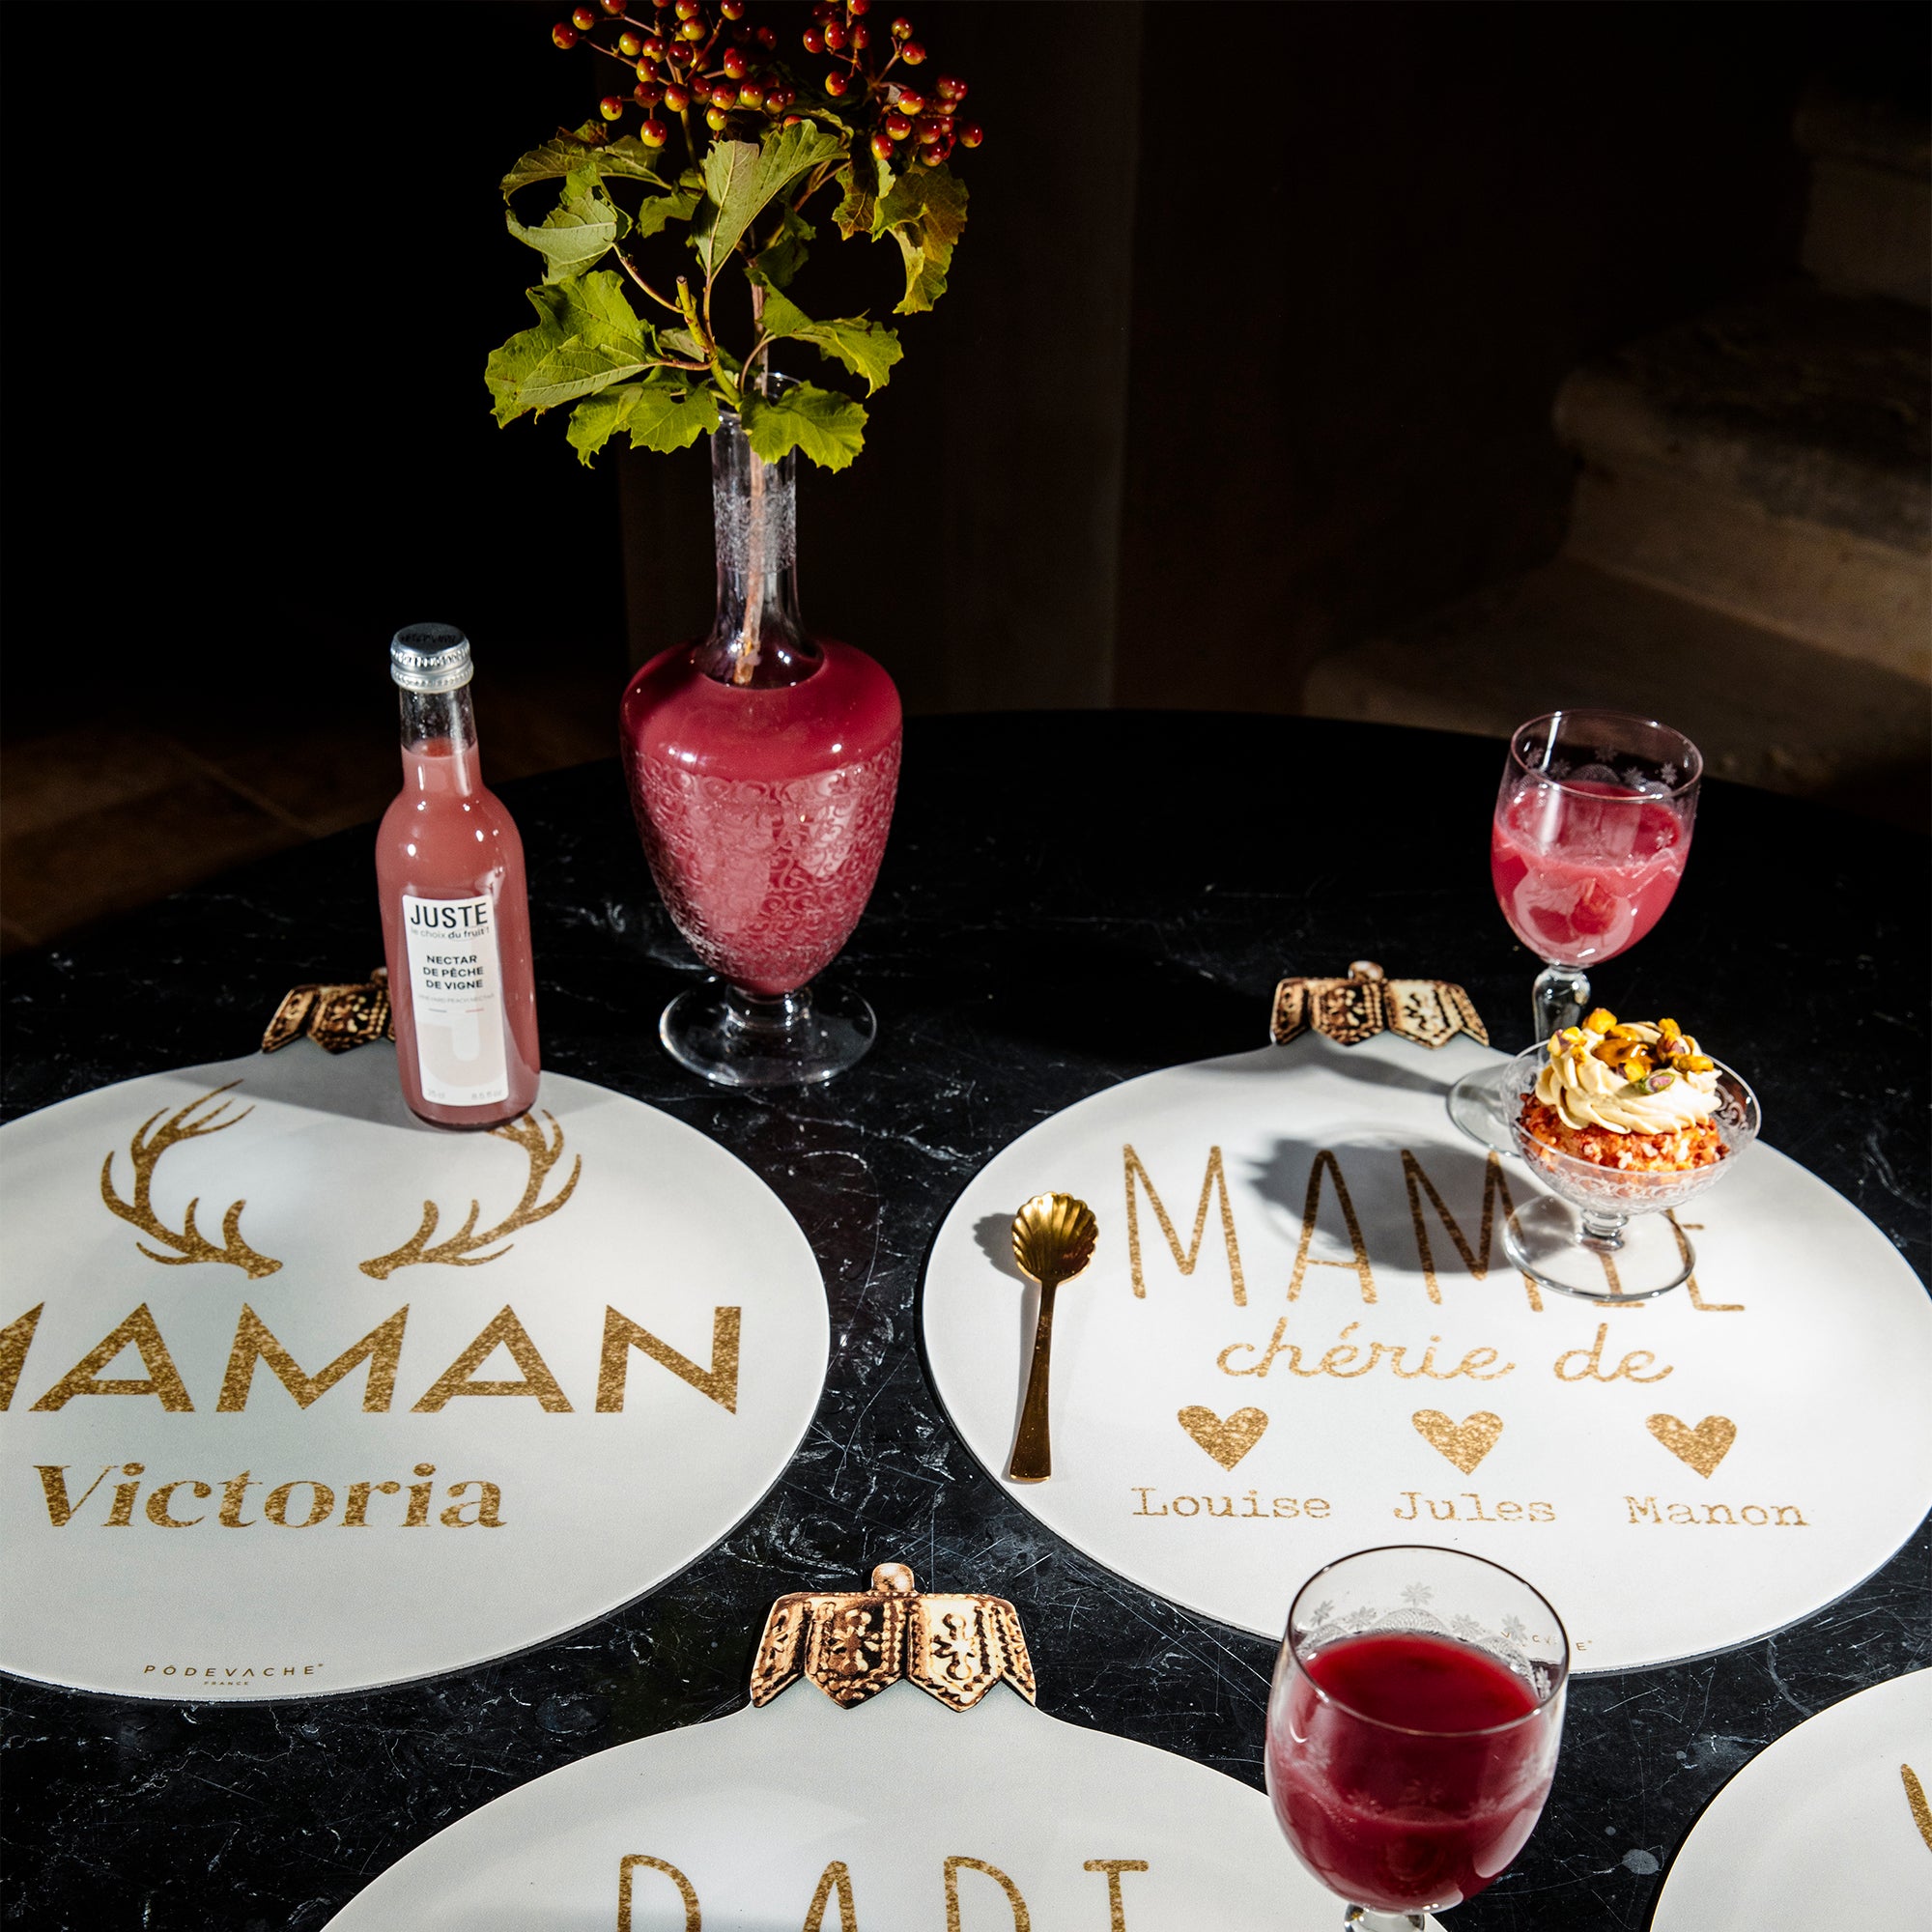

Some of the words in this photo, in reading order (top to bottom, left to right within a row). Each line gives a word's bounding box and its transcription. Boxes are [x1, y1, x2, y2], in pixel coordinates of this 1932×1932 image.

[411, 902, 488, 928] JUSTE
[420, 930, 444, 939] choix
[464, 928, 484, 938] fruit
[423, 967, 439, 977] DE
[441, 966, 484, 978] PÊCHE
[427, 954, 477, 965] NECTAR
[426, 980, 441, 989] DE
[444, 980, 483, 990] VIGNE
[0, 1302, 742, 1415] AMAN
[1217, 1316, 1516, 1380] chérie
[1553, 1323, 1674, 1383] de
[32, 1462, 507, 1528] Victoria
[1131, 1488, 1331, 1519] Louise
[1393, 1492, 1557, 1522] Jules
[1623, 1495, 1811, 1526] Manon
